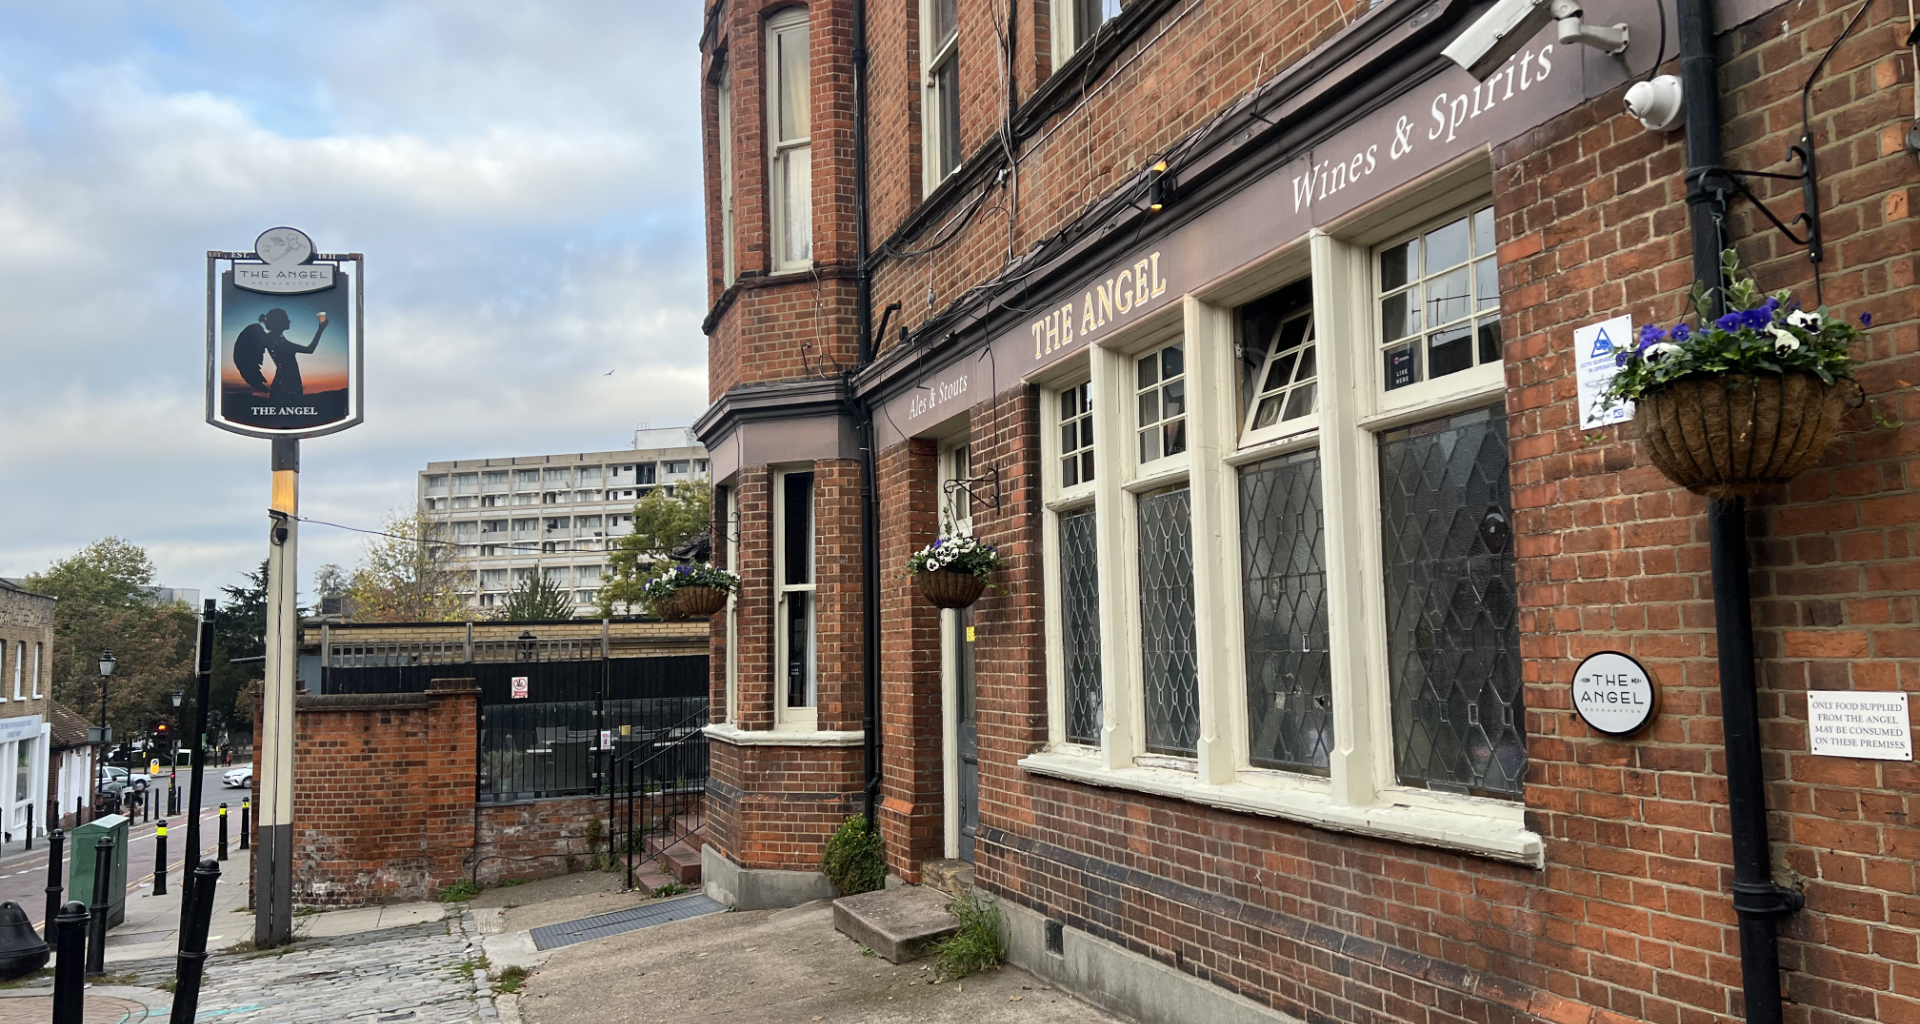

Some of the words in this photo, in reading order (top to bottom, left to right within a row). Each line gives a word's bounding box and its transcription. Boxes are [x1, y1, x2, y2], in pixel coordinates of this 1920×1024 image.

[1292, 144, 1377, 214] Wines
[1390, 115, 1414, 160] &
[1428, 44, 1553, 143] Spirits
[239, 270, 270, 279] THE
[276, 270, 328, 279] ANGEL
[1032, 303, 1073, 360] THE
[1080, 251, 1167, 336] ANGEL
[1580, 361, 1592, 369] CCTV
[909, 394, 927, 420] Ales
[929, 387, 936, 409] &
[939, 374, 968, 404] Stouts
[251, 406, 277, 415] THE
[278, 406, 318, 415] ANGEL
[1592, 673, 1628, 687] THE
[1581, 690, 1644, 705] ANGEL
[1812, 701, 1834, 710] ONLY
[1835, 702, 1859, 711] FOOD
[1860, 702, 1903, 712] SUPPLIED
[1817, 713, 1843, 722] FROM
[1845, 714, 1864, 723] THE
[1866, 715, 1898, 724] ANGEL
[1815, 725, 1834, 733] MAY
[1836, 726, 1847, 734] BE
[1849, 726, 1903, 737] CONSUMED
[1815, 737, 1828, 745] ON
[1830, 737, 1858, 747] THESE
[1860, 739, 1906, 749] PREMISES
